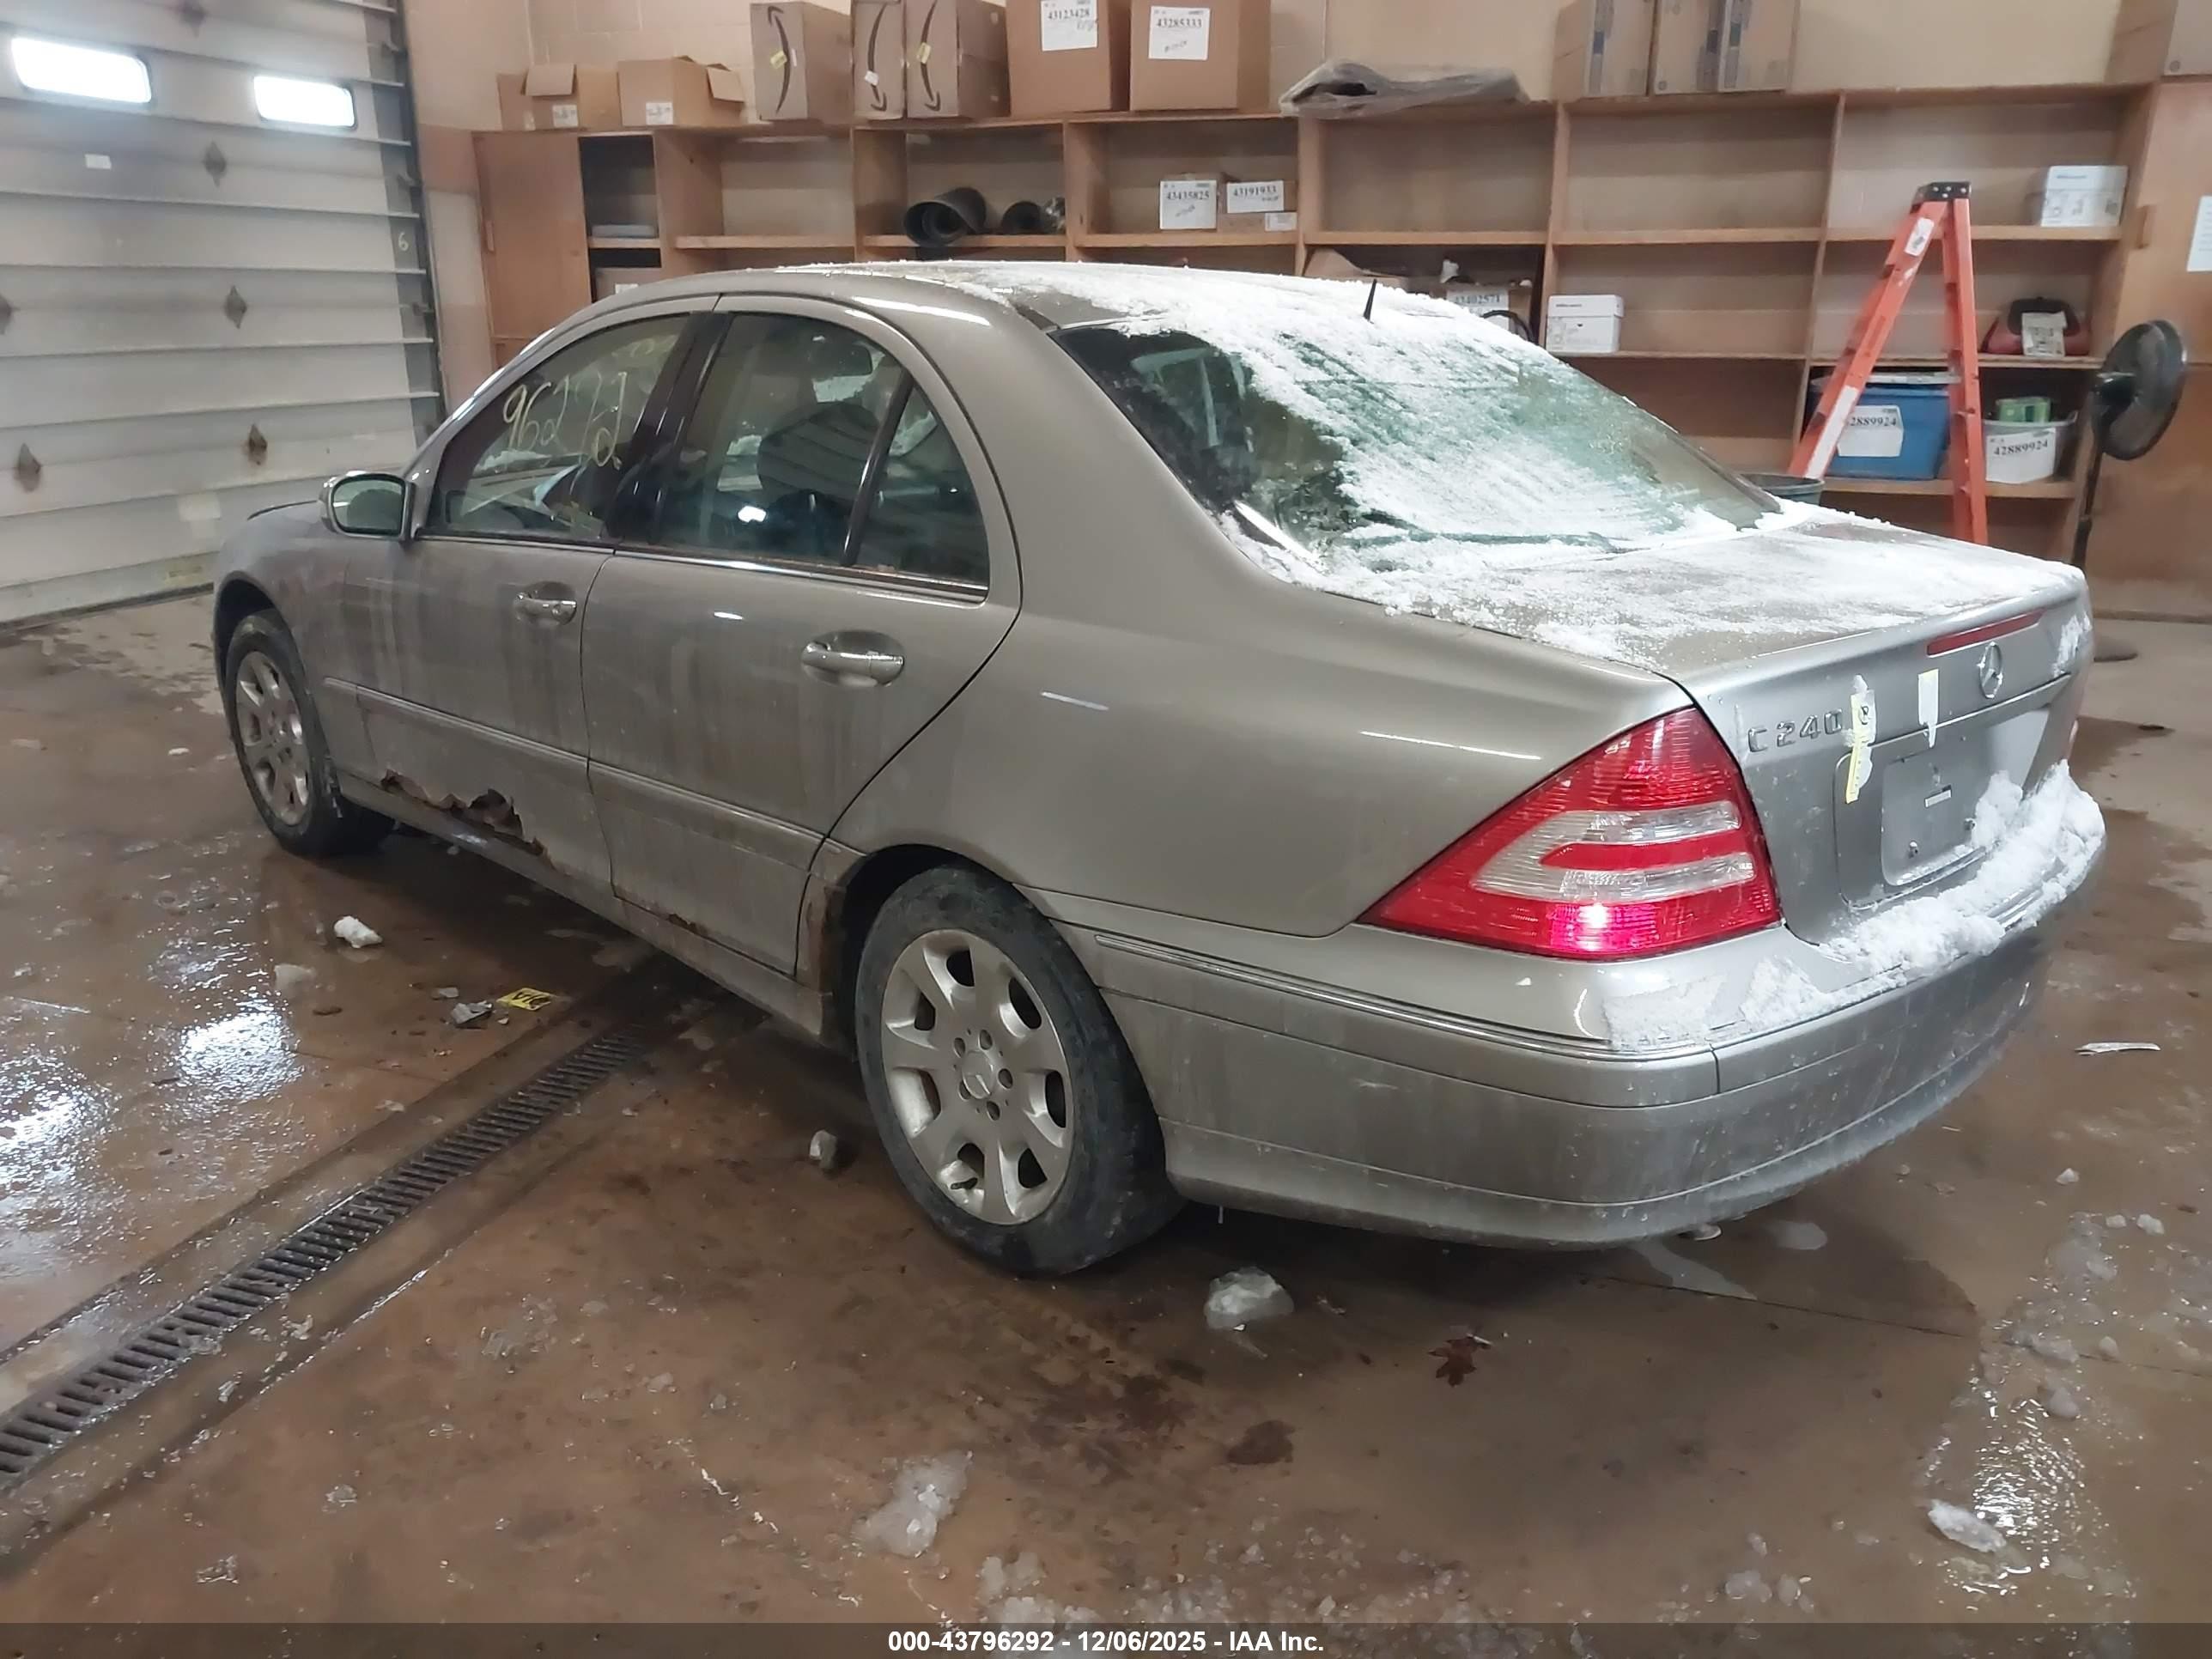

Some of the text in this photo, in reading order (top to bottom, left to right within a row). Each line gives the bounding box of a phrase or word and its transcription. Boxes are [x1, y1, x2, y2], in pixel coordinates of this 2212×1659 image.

[398, 232, 409, 251] 6
[1846, 416, 1898, 428] 2889924
[1993, 439, 2049, 457] 42889924
